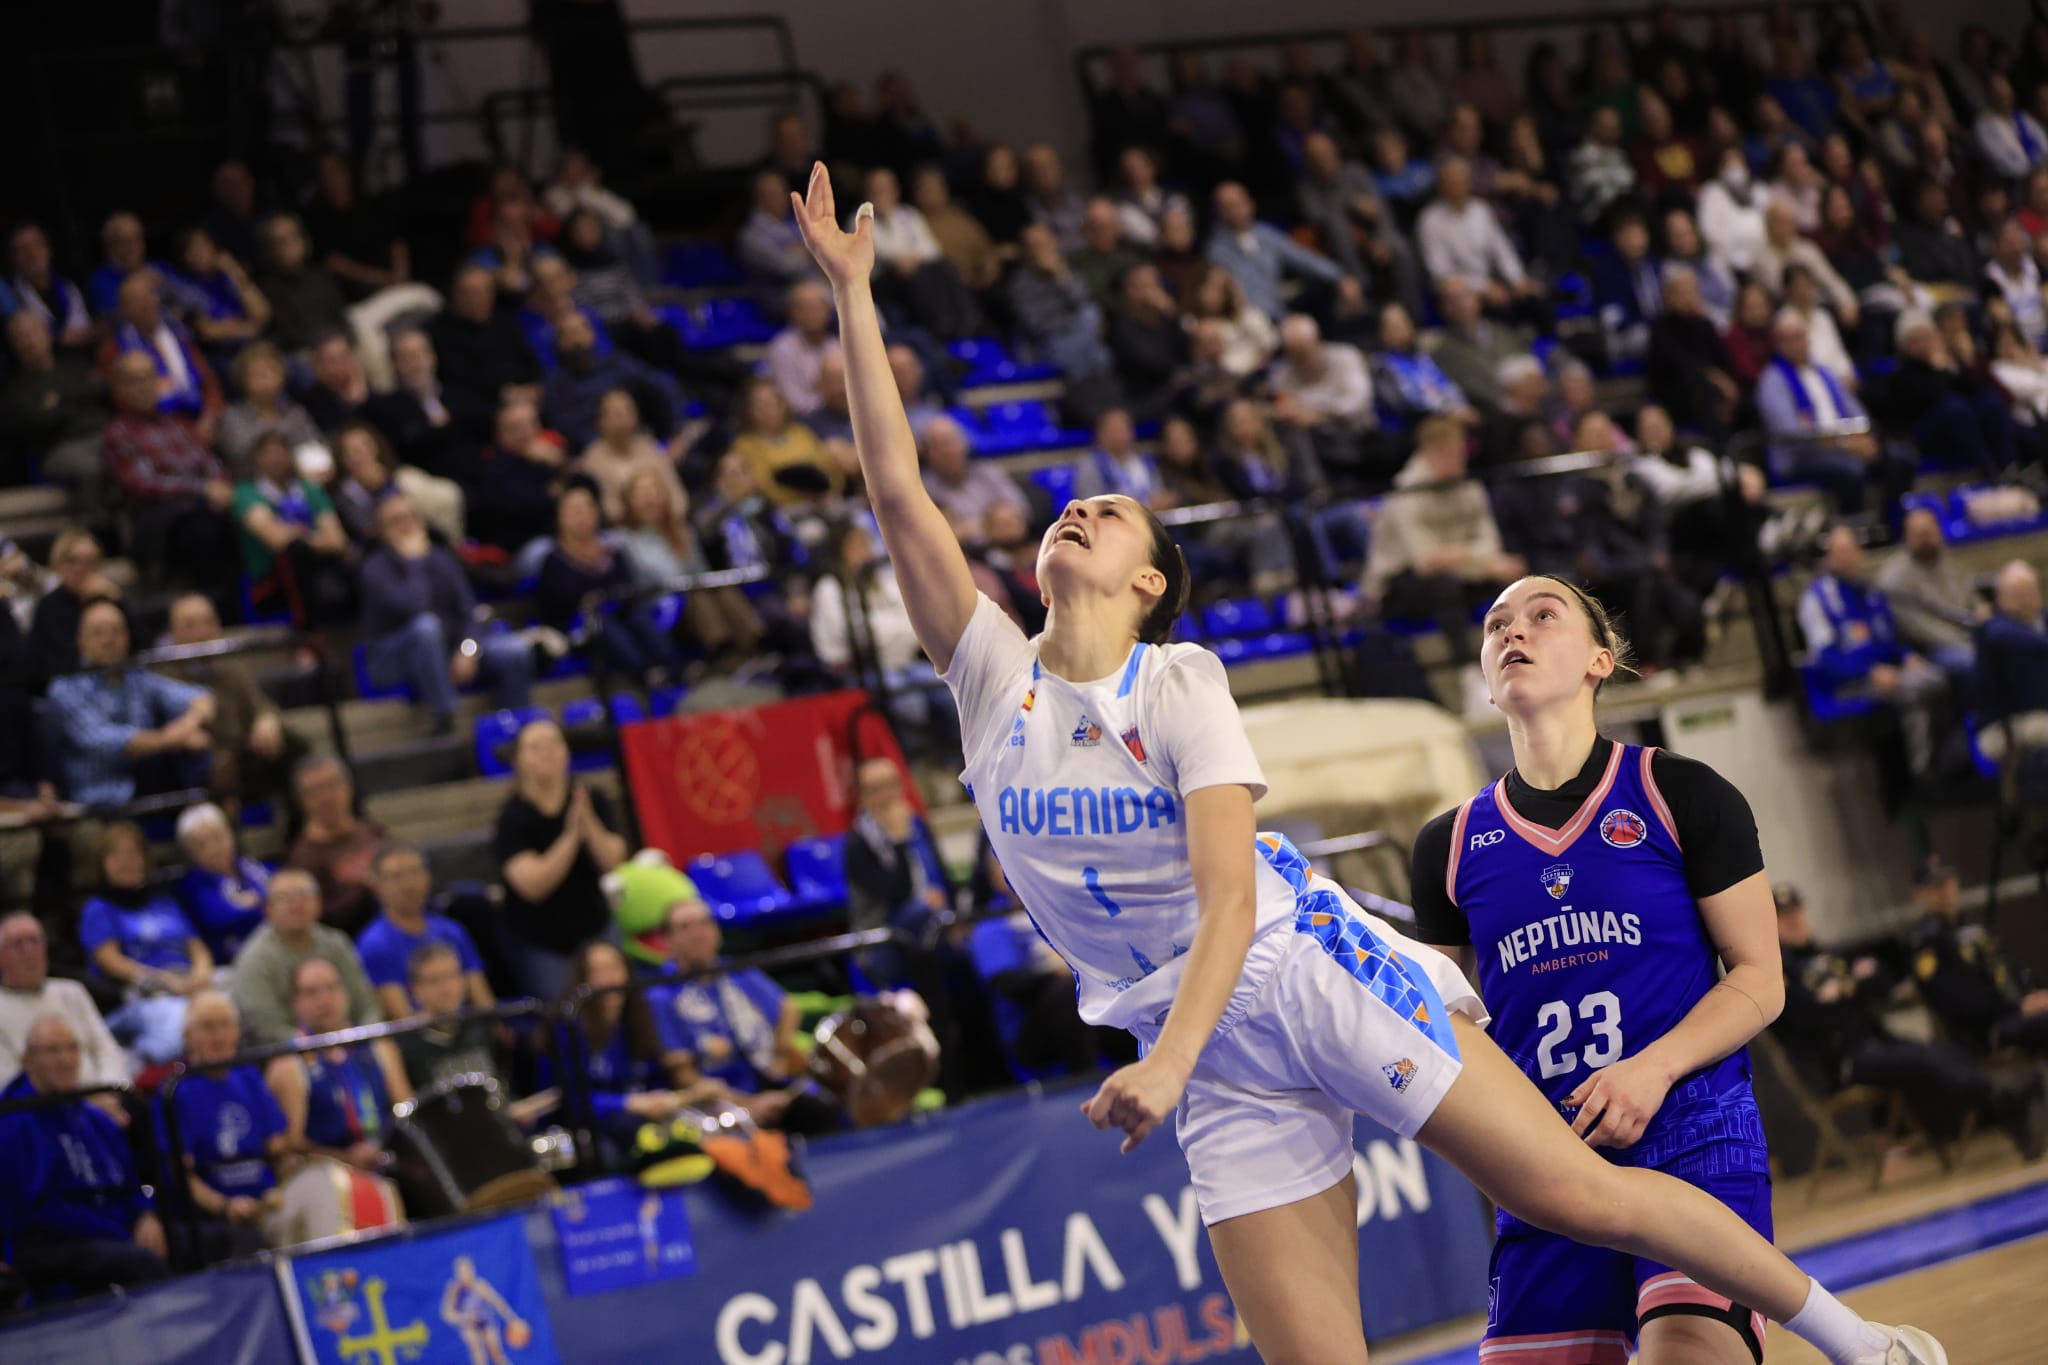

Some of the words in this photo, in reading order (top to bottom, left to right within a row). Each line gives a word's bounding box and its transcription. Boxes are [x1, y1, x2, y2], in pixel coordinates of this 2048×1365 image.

[999, 785, 1177, 836] AVENIDA
[1081, 866, 1122, 919] 1
[1497, 905, 1642, 974] NEPTŪNAS
[1531, 949, 1610, 976] AMBERTON
[1537, 990, 1624, 1080] 23
[715, 1211, 1126, 1365] CASTILLA
[1142, 1183, 1203, 1292] Y
